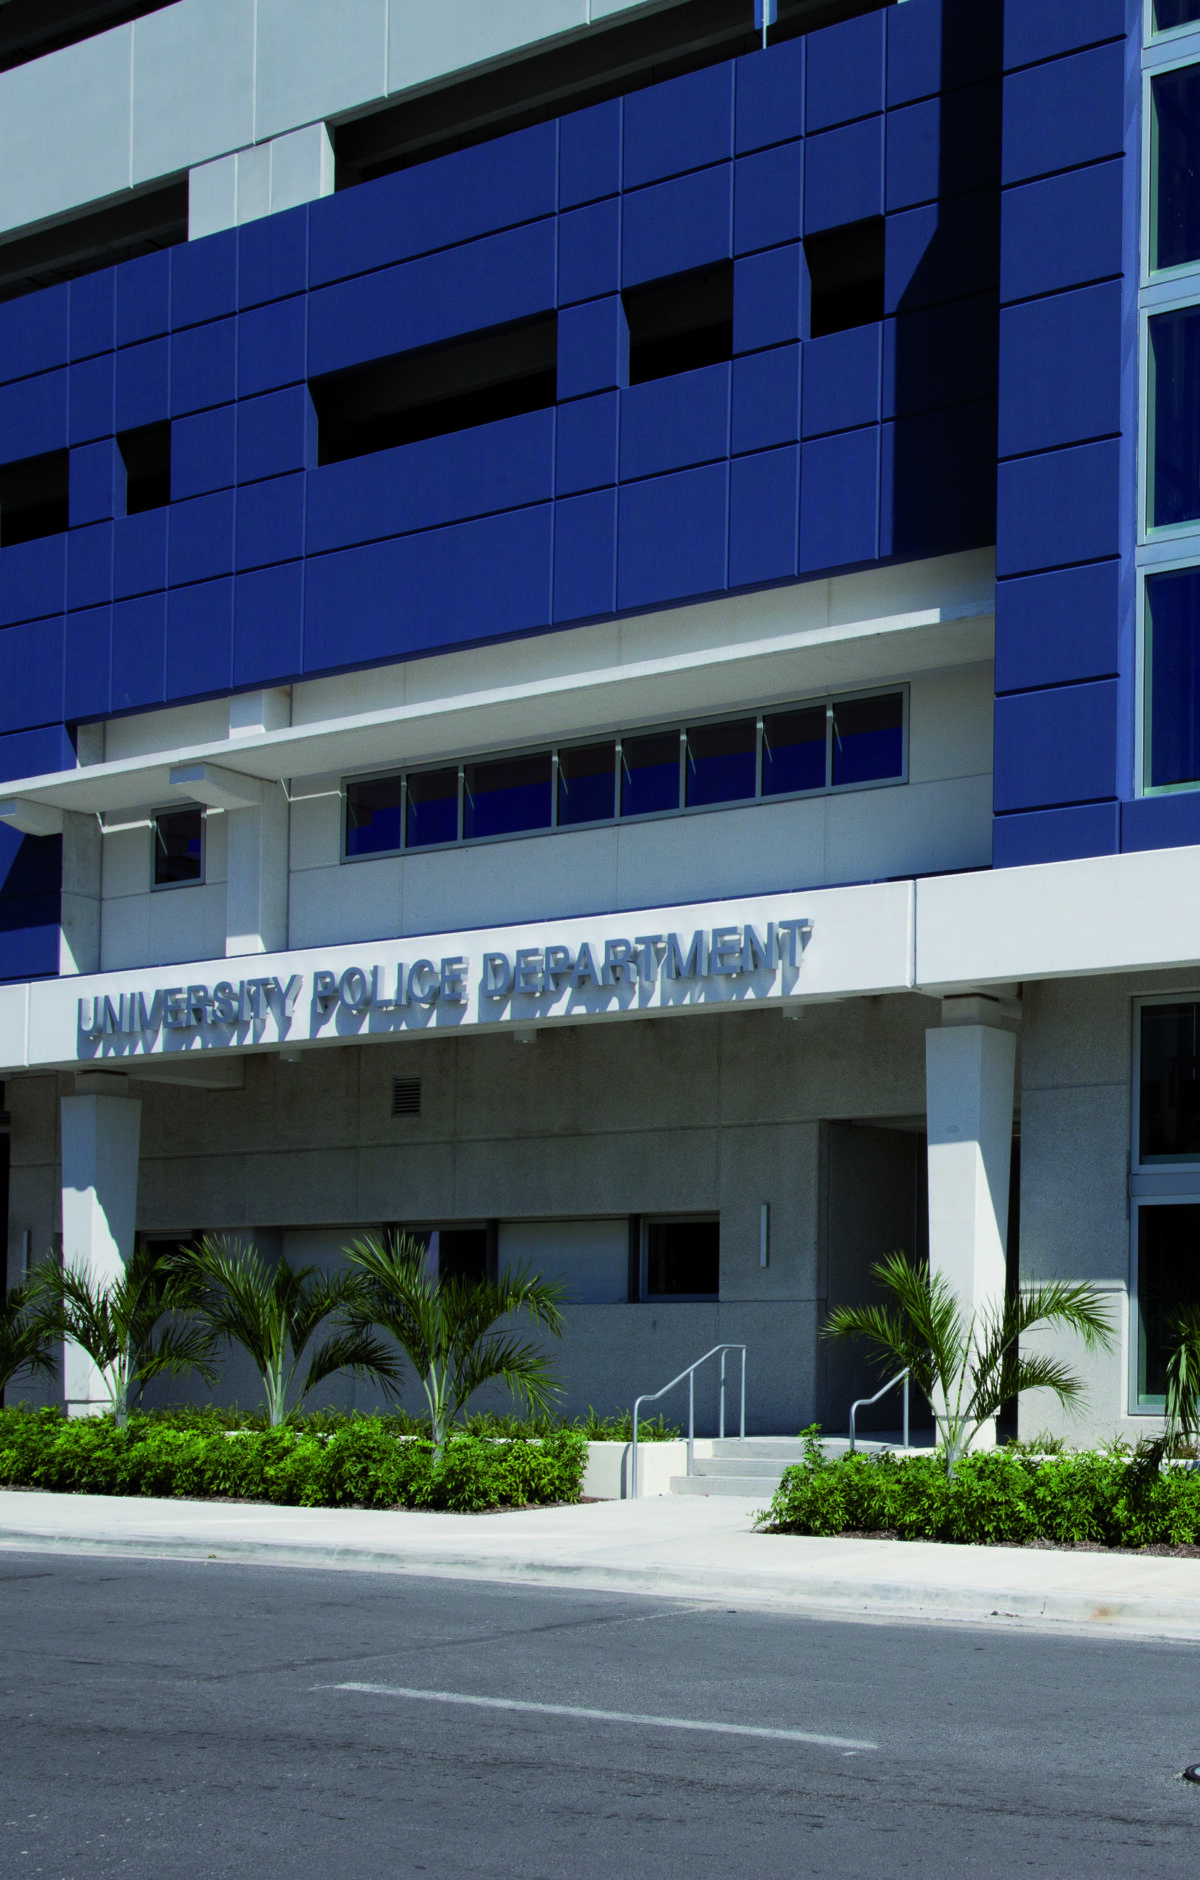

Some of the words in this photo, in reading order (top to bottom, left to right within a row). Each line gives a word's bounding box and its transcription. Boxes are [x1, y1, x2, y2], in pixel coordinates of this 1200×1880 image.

[78, 974, 303, 1034] UNIVERSITY
[312, 956, 469, 1012] POLICE
[482, 918, 813, 997] DEPARTMENT
